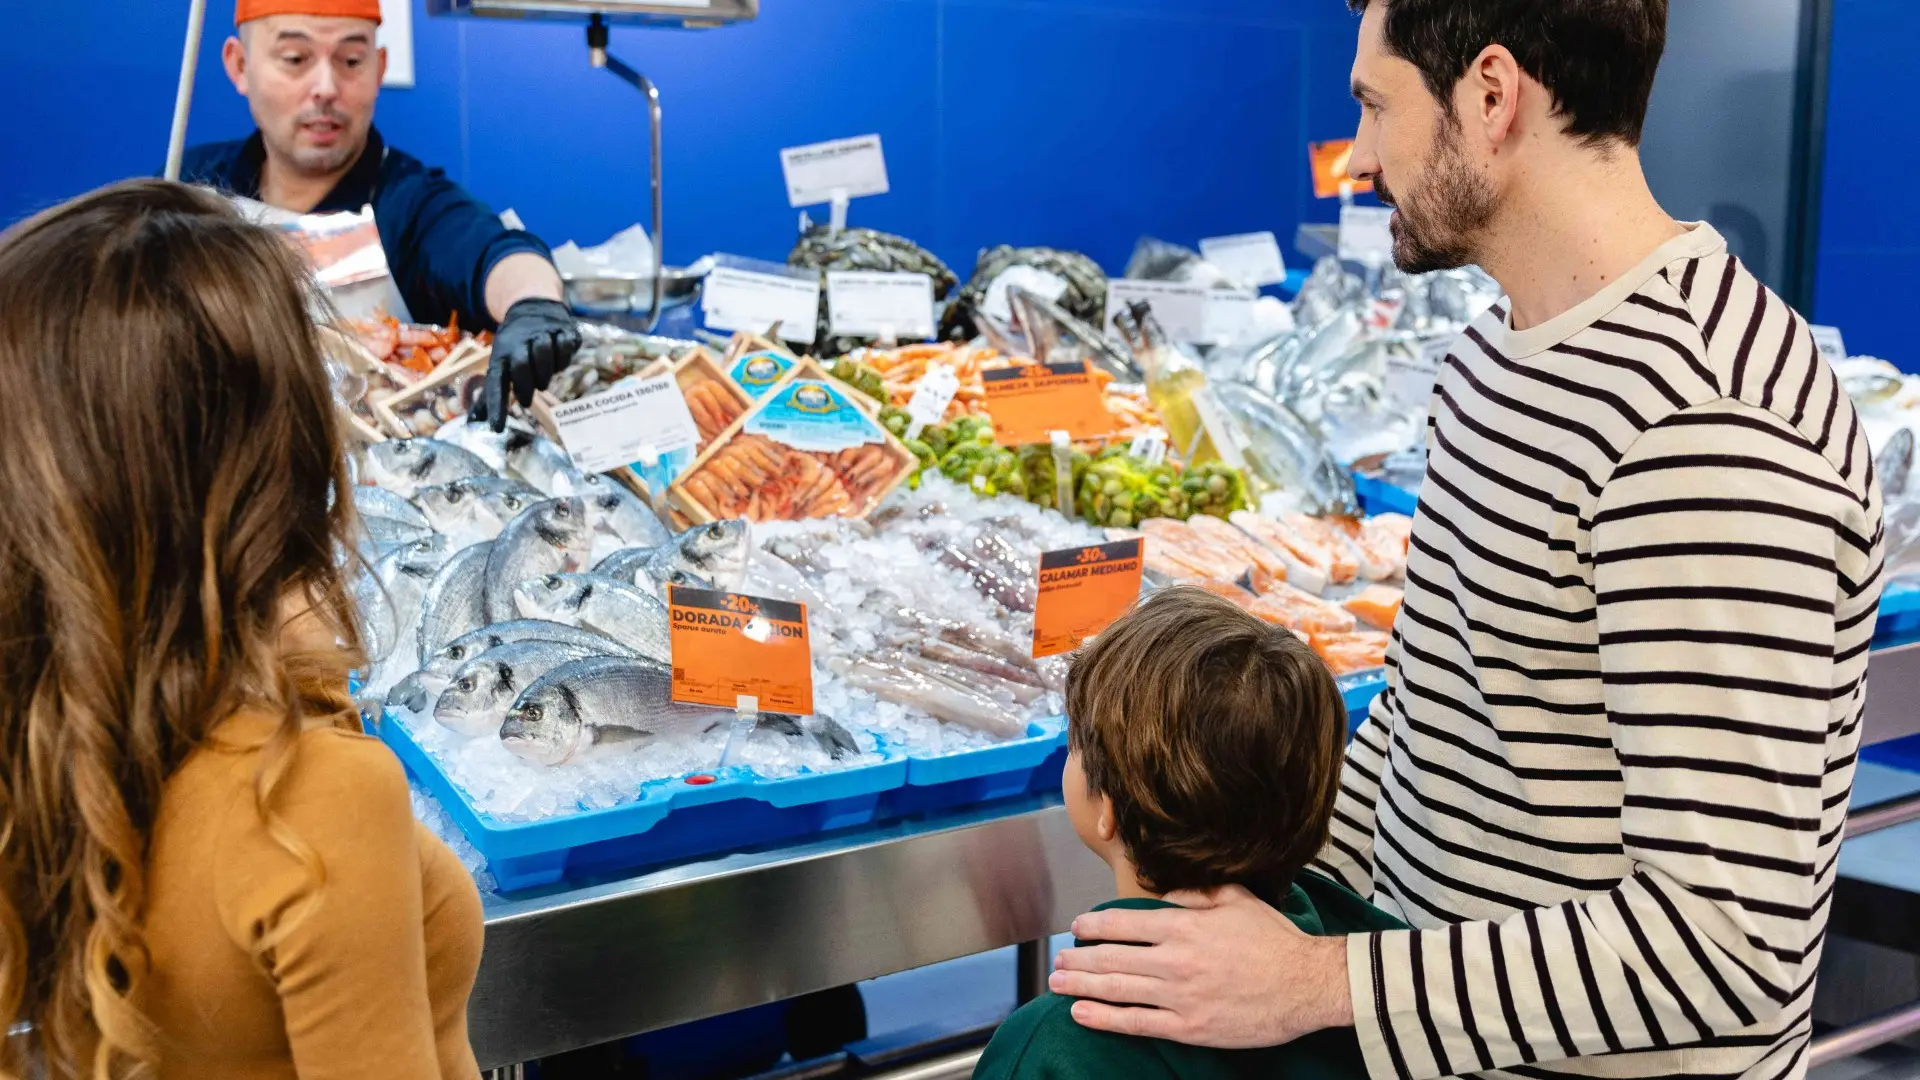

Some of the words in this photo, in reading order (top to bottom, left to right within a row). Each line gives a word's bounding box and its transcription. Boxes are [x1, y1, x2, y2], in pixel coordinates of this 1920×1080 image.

[555, 403, 593, 419] GAMBA
[594, 391, 635, 408] COCIDA
[1040, 567, 1089, 583] CALAMAR
[1090, 561, 1138, 577] MEDIANO
[720, 593, 761, 614] -20%
[673, 609, 742, 629] DORADA
[673, 622, 699, 632] Sparus
[701, 626, 727, 635] aurata
